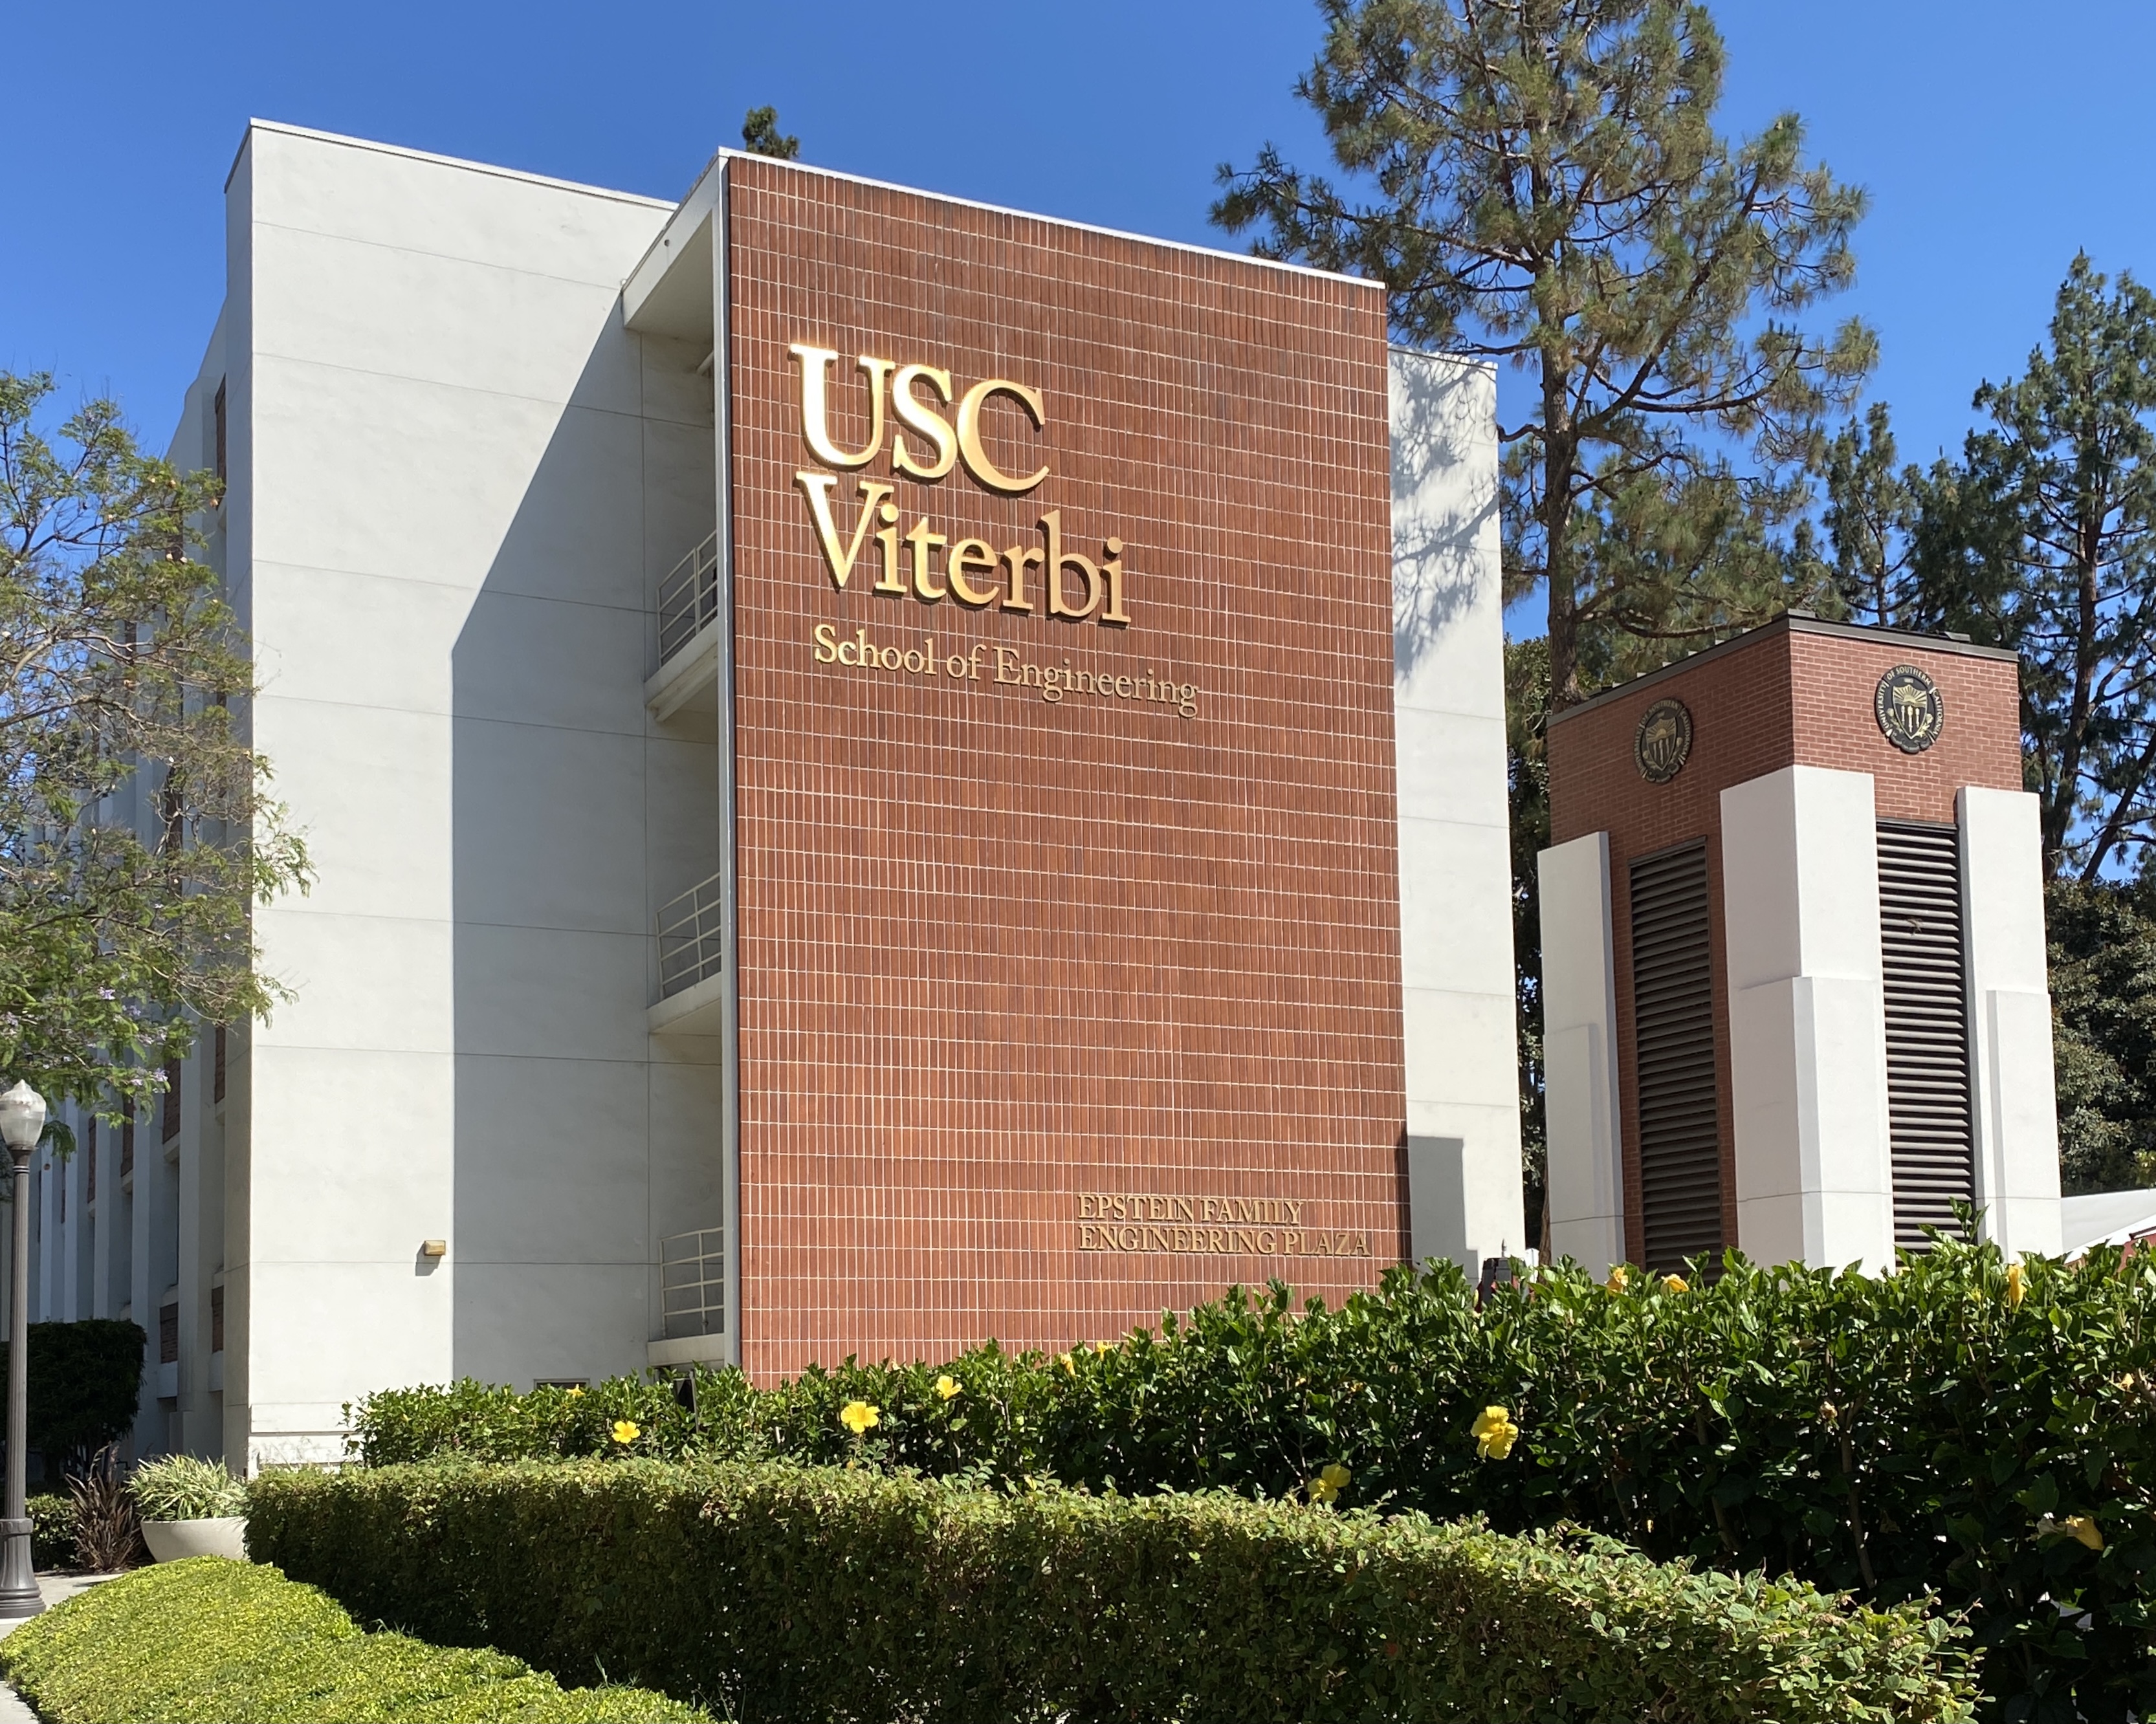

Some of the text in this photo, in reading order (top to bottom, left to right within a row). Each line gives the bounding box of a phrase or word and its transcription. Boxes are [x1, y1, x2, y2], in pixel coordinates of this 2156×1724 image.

[789, 343, 1050, 495] USC
[795, 471, 1132, 627] Viterbi
[814, 624, 1198, 717] School of Engineering
[1876, 681, 1889, 730] UNIVERSITY
[1887, 670, 1895, 681] OF
[1896, 666, 1931, 686] SOUTHERN
[1077, 1194, 1304, 1225] EPSTEIN FAMILY
[1079, 1226, 1371, 1256] ENGINEERING PLAZA
